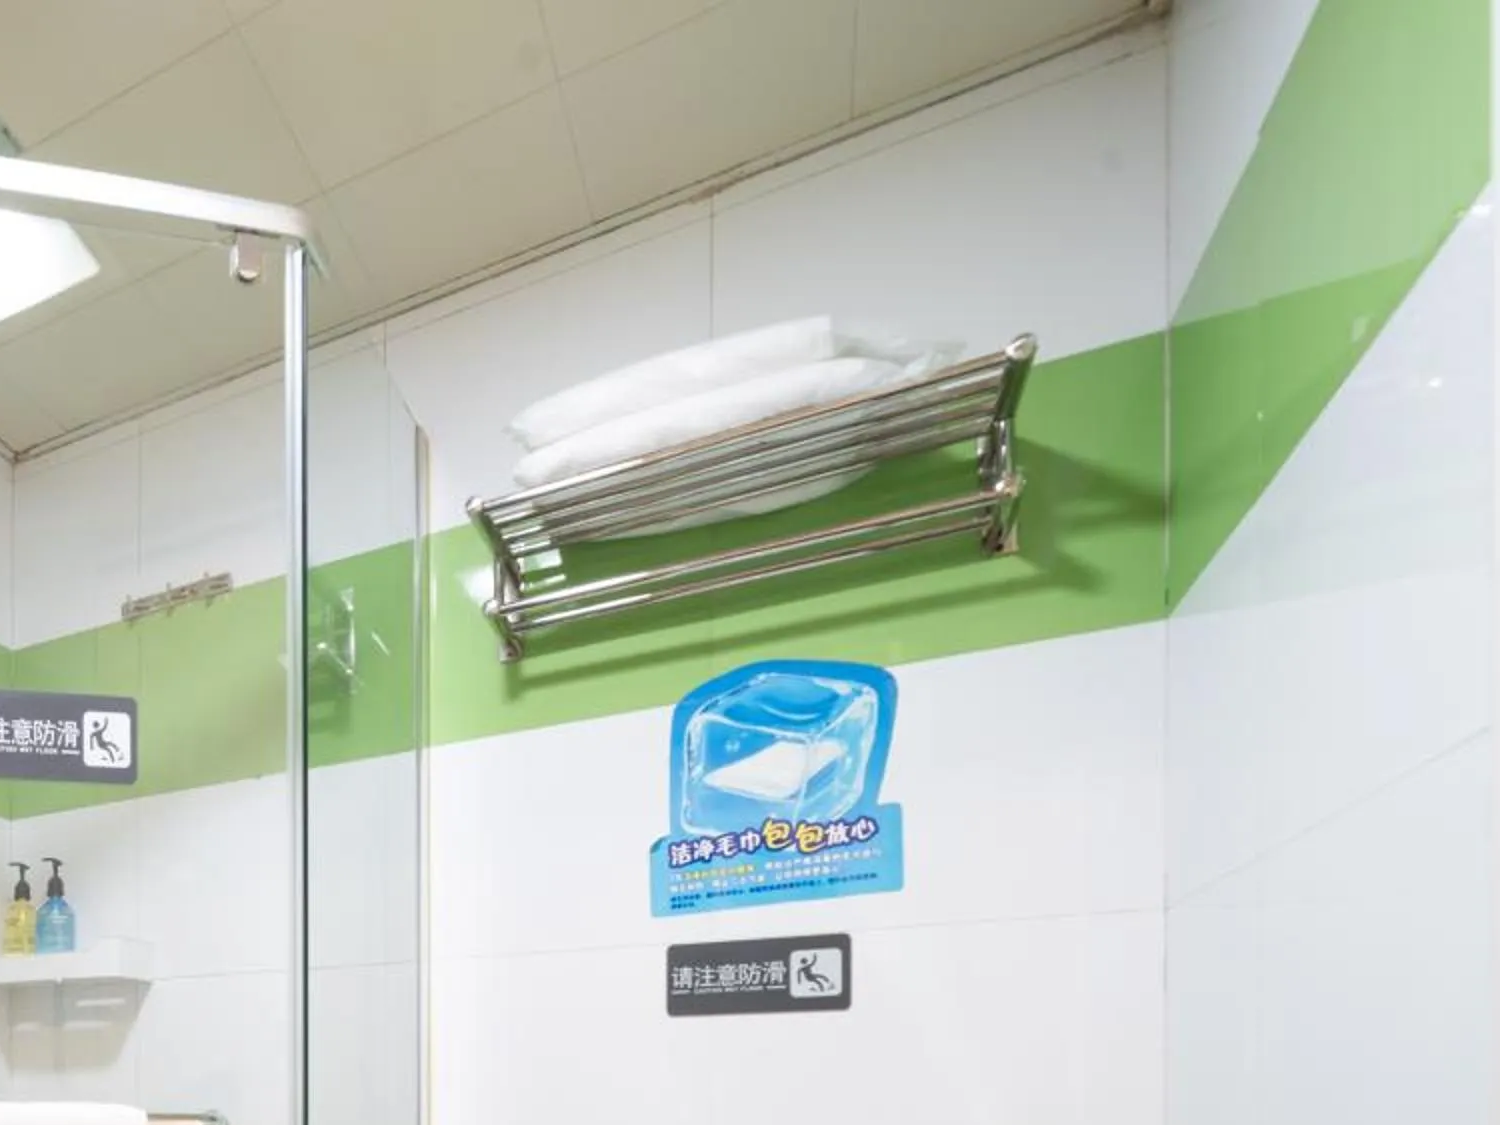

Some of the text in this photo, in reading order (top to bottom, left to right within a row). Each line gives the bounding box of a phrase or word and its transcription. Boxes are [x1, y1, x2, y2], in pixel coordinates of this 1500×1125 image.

[669, 817, 877, 867] 洁净毛巾包包放心
[671, 960, 787, 989] 请注意防滑
